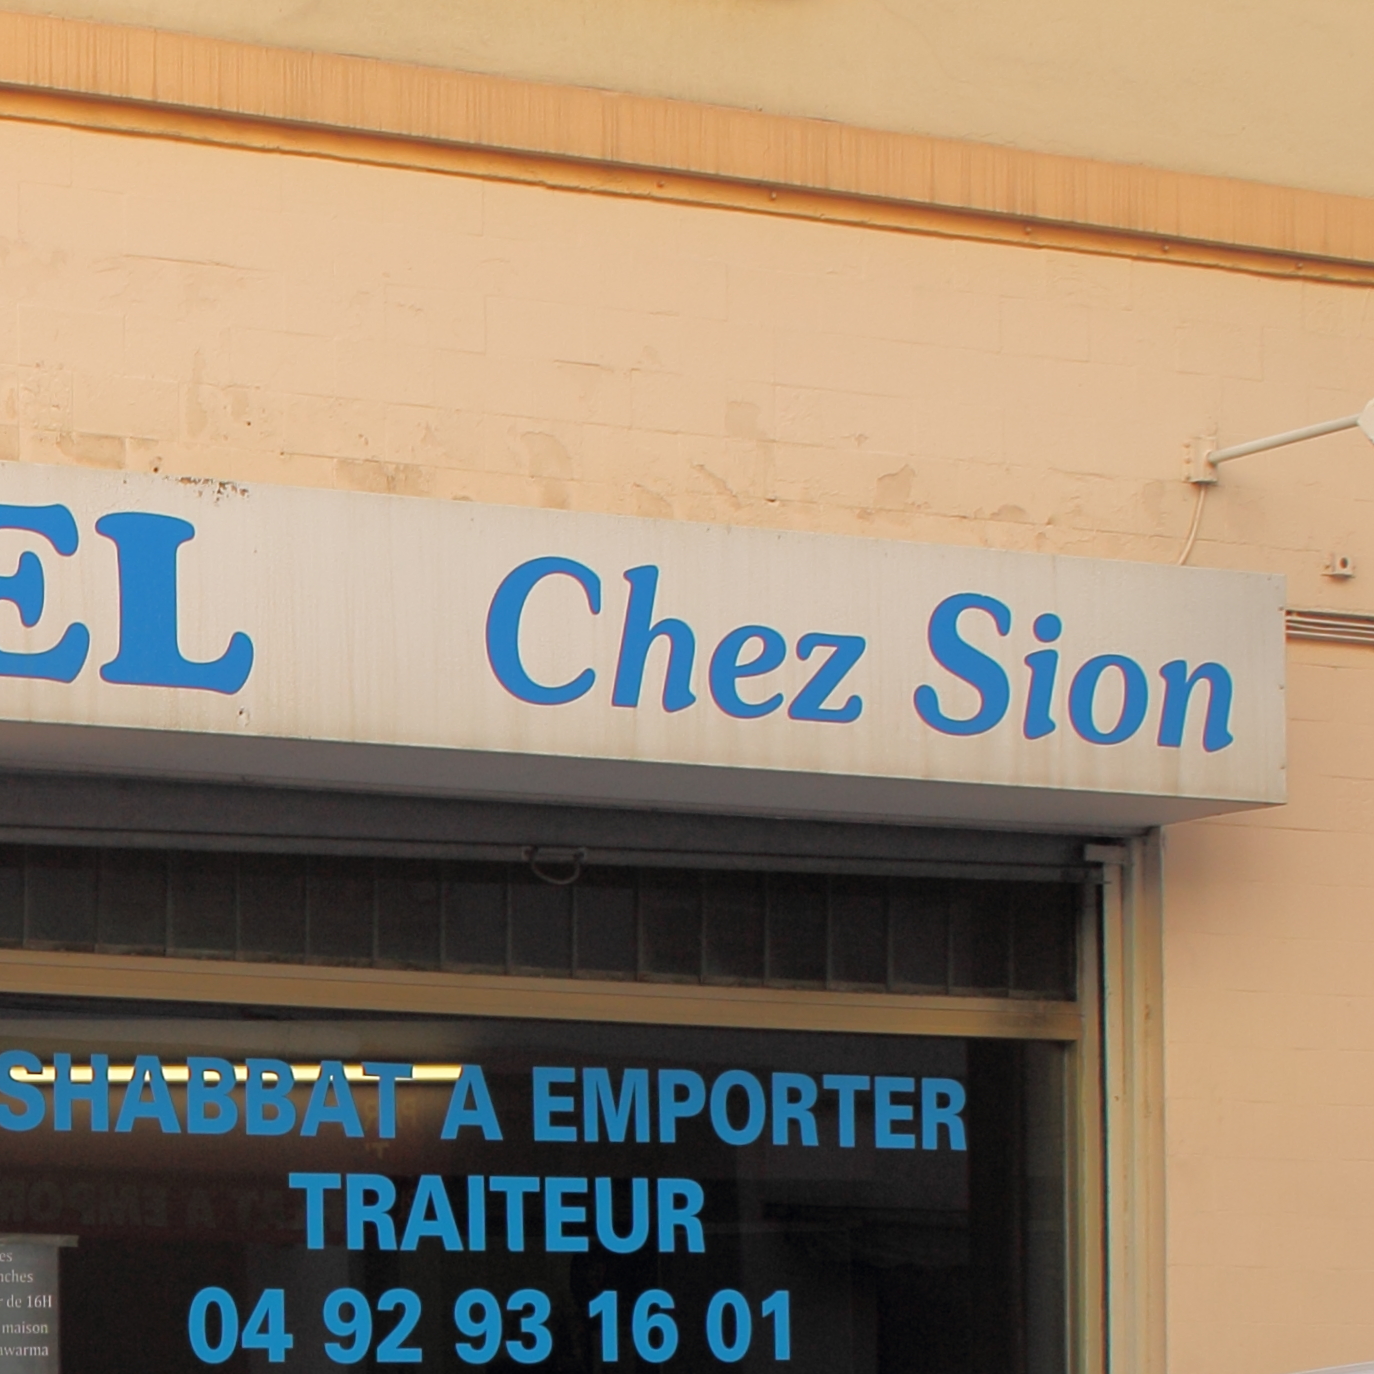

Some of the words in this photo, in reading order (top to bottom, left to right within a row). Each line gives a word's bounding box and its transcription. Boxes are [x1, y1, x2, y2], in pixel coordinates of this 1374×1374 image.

[486, 555, 867, 723] Chez
[914, 592, 1234, 752] Sion
[440, 1064, 503, 1142] A
[531, 1066, 967, 1152] EMPORTER
[287, 1171, 706, 1255] TRAITEUR
[2, 1322, 49, 1334] maison
[6, 1294, 22, 1308] de
[26, 1295, 53, 1309] 16H
[187, 1285, 294, 1365] 04
[322, 1286, 424, 1365] 92
[453, 1287, 554, 1366] 93
[587, 1288, 680, 1364] 16
[705, 1287, 792, 1364] 01
